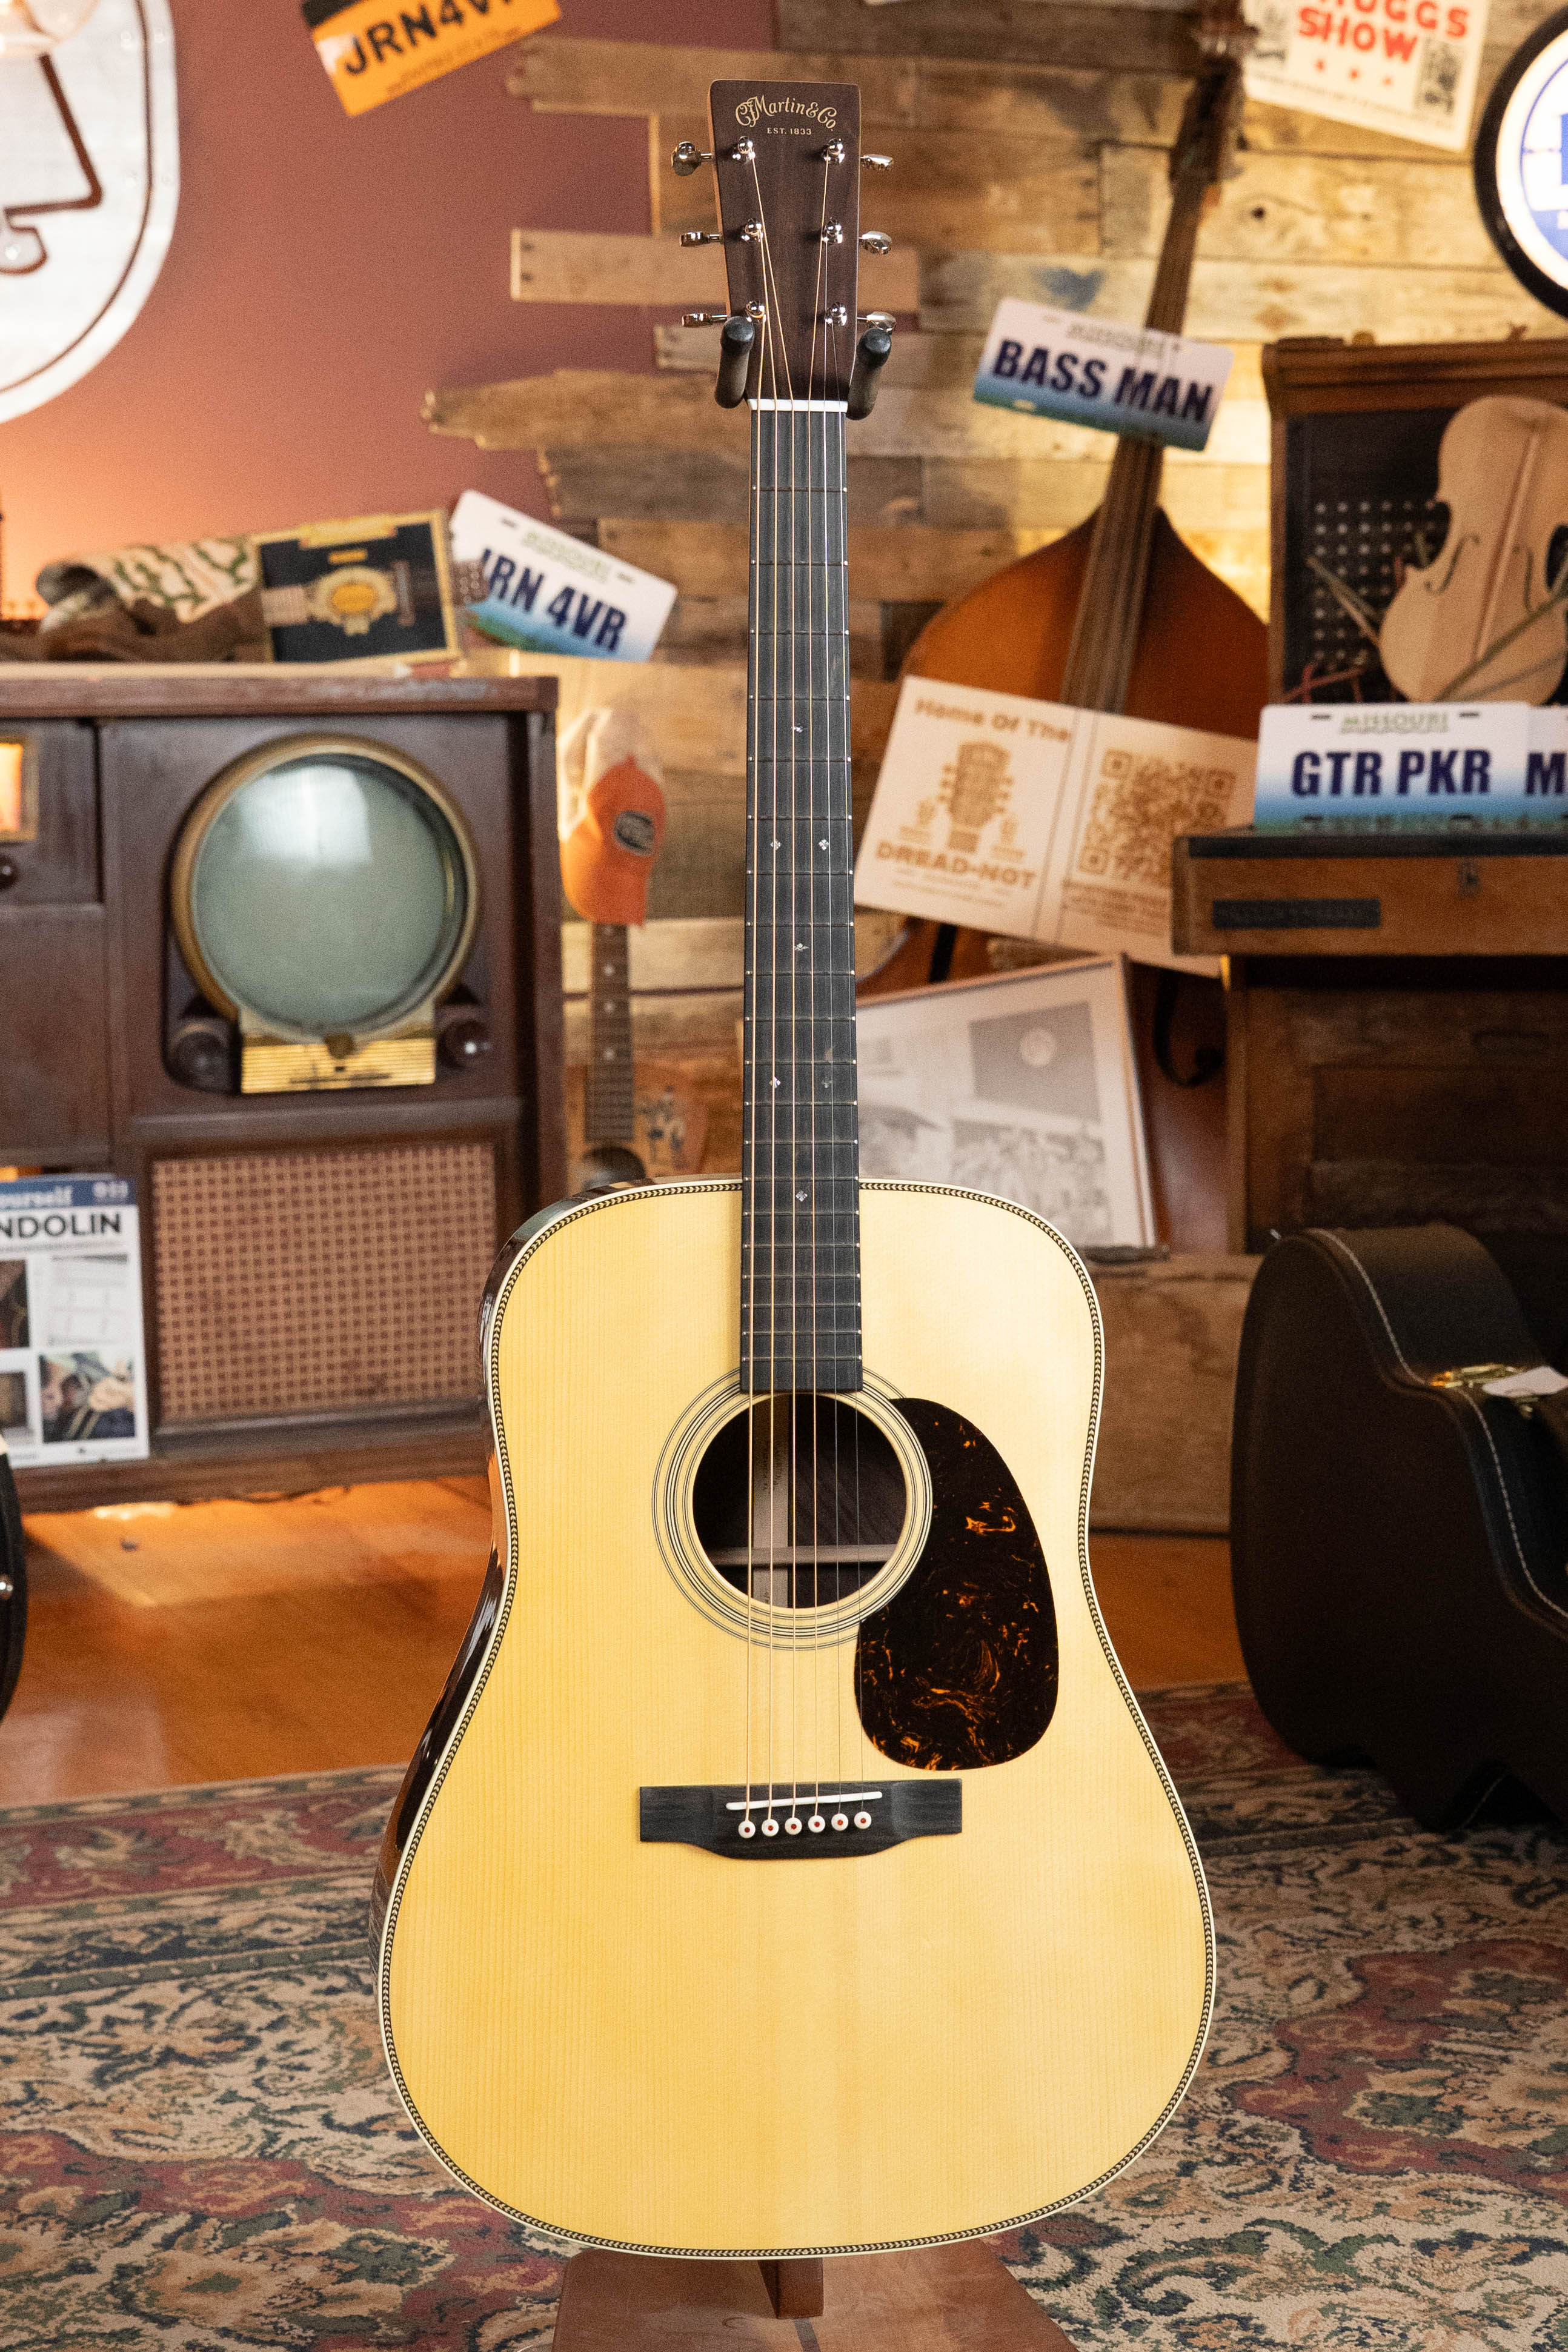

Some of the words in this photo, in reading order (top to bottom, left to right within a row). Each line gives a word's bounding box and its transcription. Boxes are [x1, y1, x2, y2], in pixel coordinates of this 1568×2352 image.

[1299, 7, 1418, 62] SHOW
[993, 339, 1108, 399] BASS
[1114, 366, 1215, 422] MAN
[548, 585, 627, 653] 4VR
[1291, 750, 1383, 797] GTR
[1395, 749, 1492, 796] PKR
[875, 840, 1035, 889] DREAD-NOT
